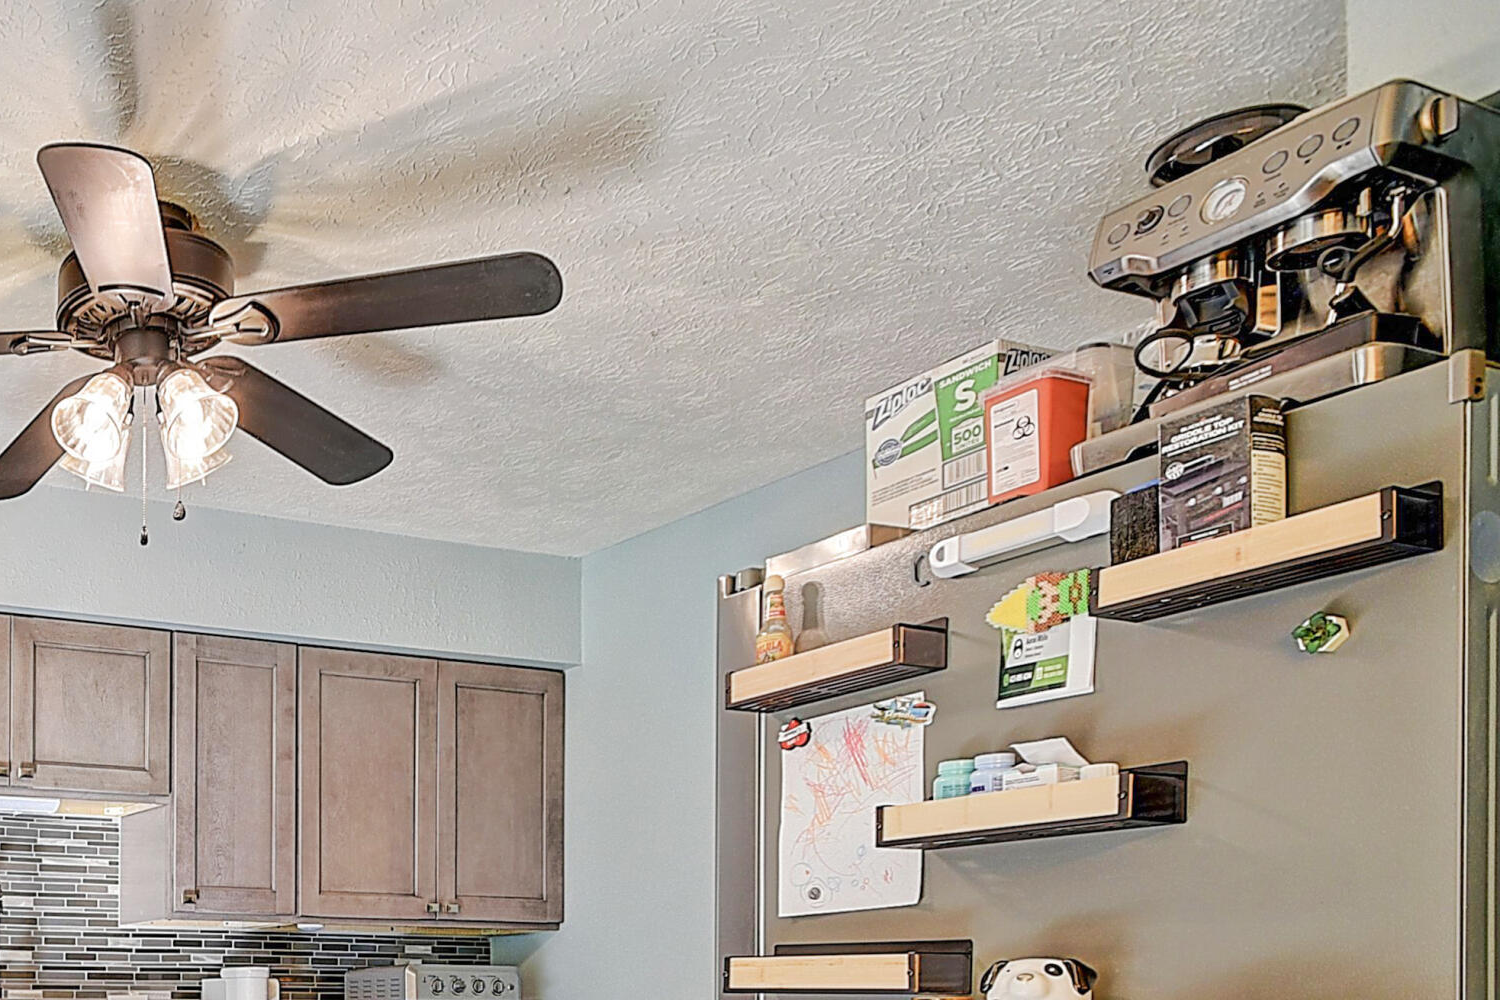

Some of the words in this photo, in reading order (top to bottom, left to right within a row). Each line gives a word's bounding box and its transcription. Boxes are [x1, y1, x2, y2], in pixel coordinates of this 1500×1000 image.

[939, 359, 992, 389] SANDWICH
[872, 377, 933, 431] Ziploc
[954, 379, 976, 412] S
[954, 425, 981, 445] 500
